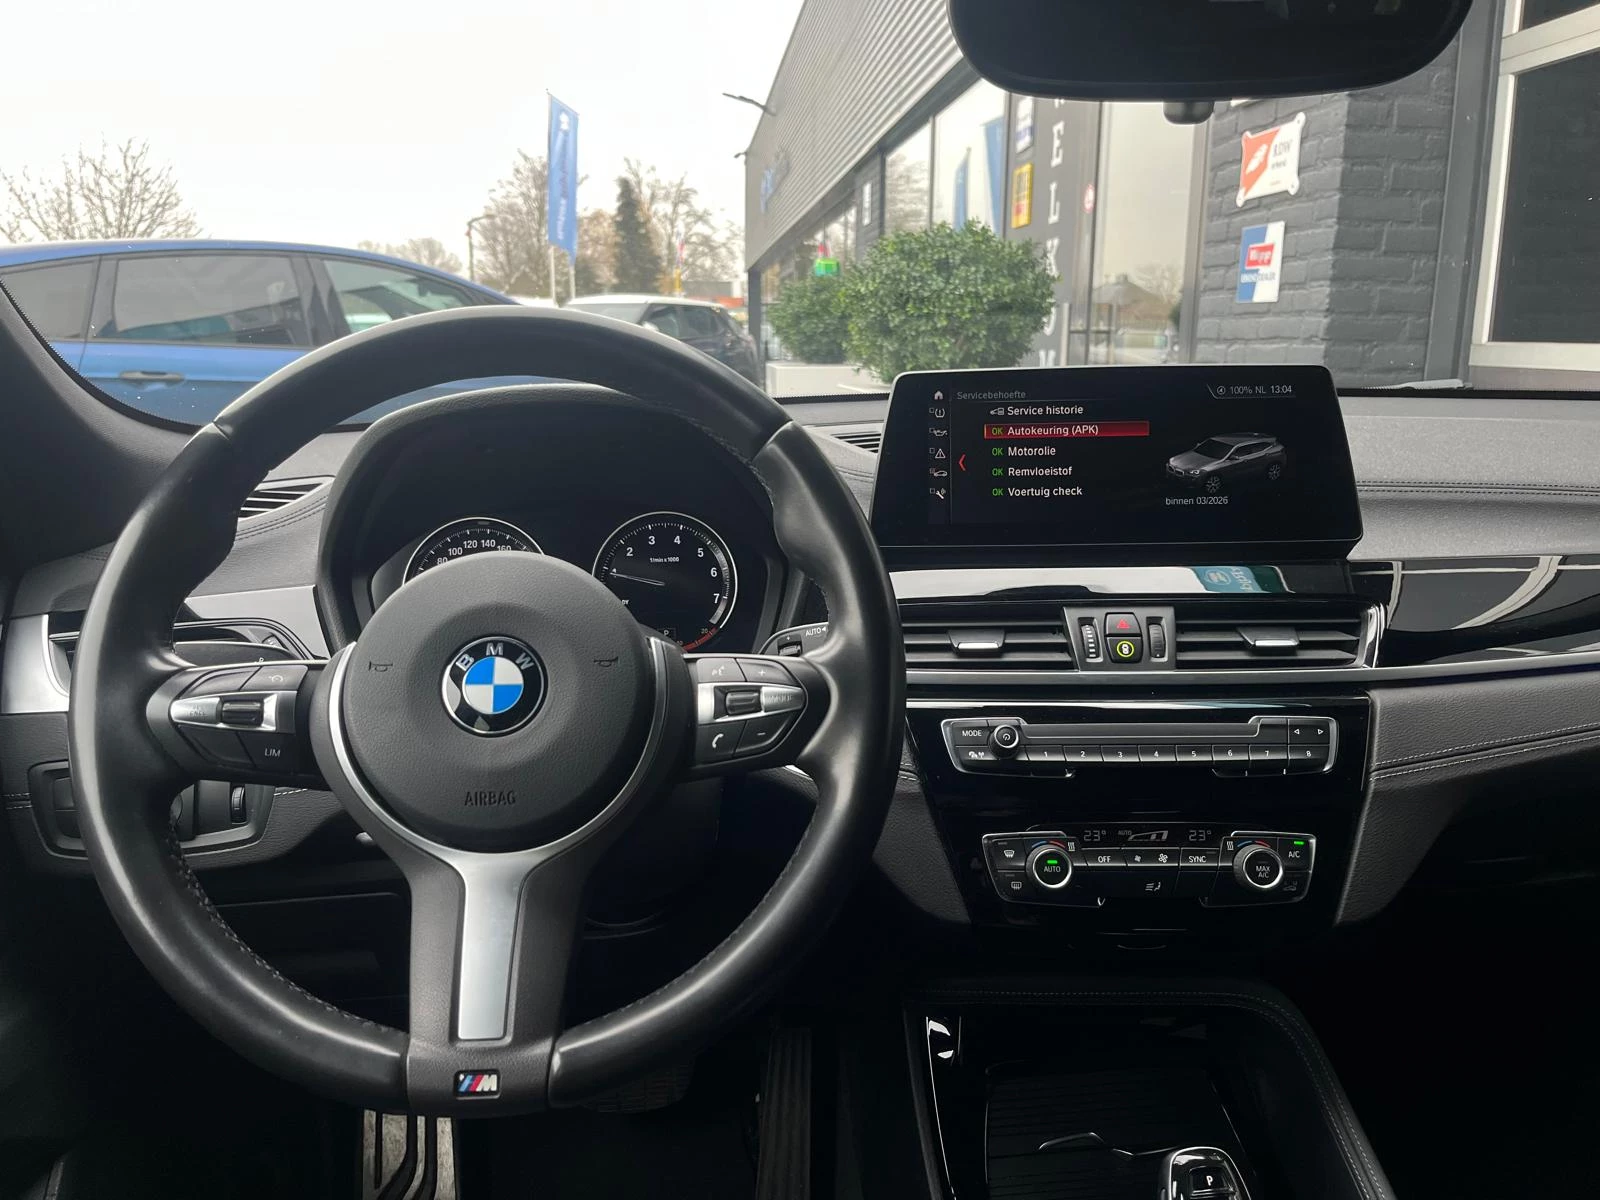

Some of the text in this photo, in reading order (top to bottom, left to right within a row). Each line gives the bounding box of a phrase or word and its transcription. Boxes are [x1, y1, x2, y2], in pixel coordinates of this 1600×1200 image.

[1230, 385, 1292, 394] 100% NL 13:04
[956, 391, 1026, 400] Servicebehoefte
[1007, 404, 1084, 416] Service historie
[992, 424, 1099, 436] OK Autokeuring (APK)
[992, 446, 1056, 456] OK Motorolie
[992, 466, 1073, 476] OK Remvloeistof
[992, 486, 1083, 498] OK Voertuig check
[1166, 496, 1228, 505] binnen 03/2026
[463, 540, 478, 548] 120
[480, 540, 496, 548] 140
[648, 536, 656, 545] 3
[674, 536, 681, 544] 4
[448, 547, 463, 556] 100
[626, 547, 634, 556] 2
[697, 548, 704, 558] 5
[436, 556, 448, 566] 80
[710, 568, 718, 578] 6
[713, 593, 720, 604] 7
[805, 626, 821, 636] AUTO
[456, 642, 535, 672] BMW
[264, 748, 281, 757] LIM
[464, 790, 516, 806] AIRBAG
[1288, 850, 1300, 858] A/C
[1206, 1175, 1214, 1186] P
